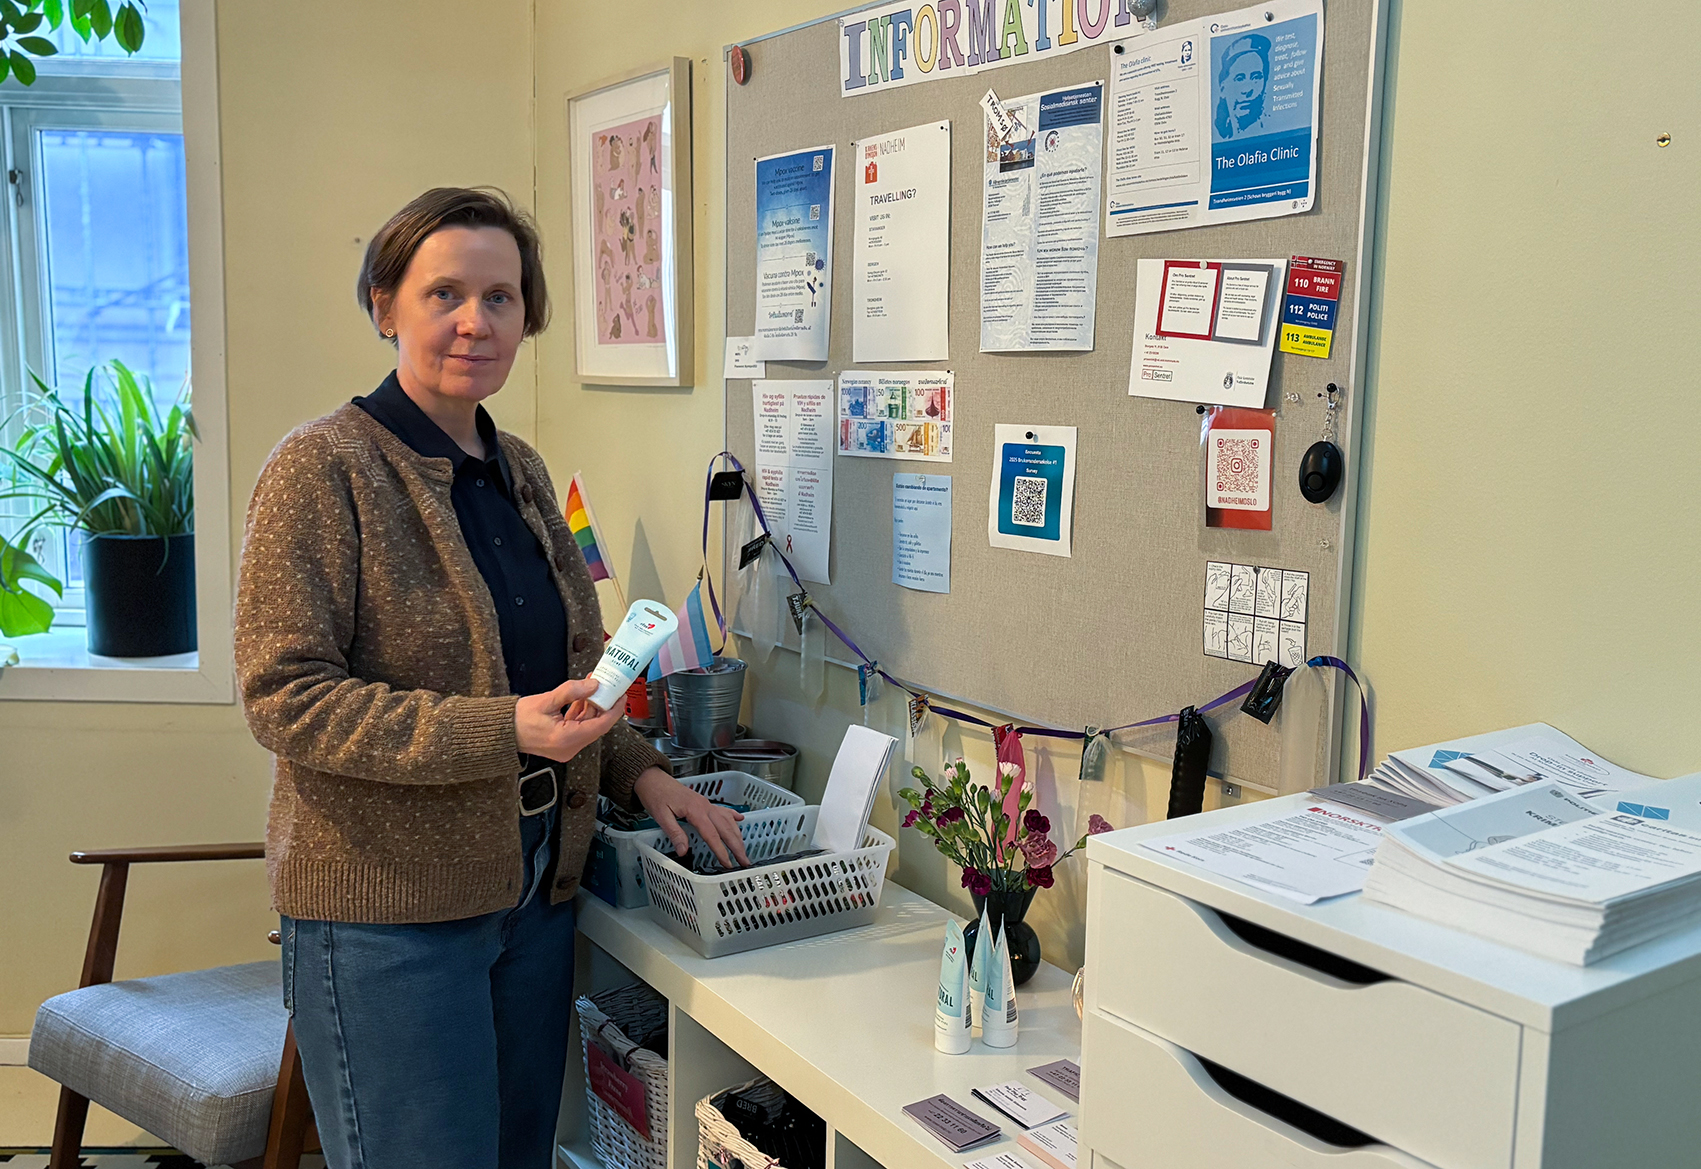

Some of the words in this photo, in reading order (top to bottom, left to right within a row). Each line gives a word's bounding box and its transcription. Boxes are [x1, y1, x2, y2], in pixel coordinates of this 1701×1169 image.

[842, 0, 1147, 92] INFORMATIO
[1283, 61, 1293, 69] and
[1294, 60, 1305, 68] give
[1273, 72, 1290, 81] advice
[1290, 69, 1305, 77] about
[1273, 82, 1294, 91] Sexually
[1273, 90, 1304, 102] Transmitted
[1272, 101, 1298, 112] Infections
[879, 137, 906, 156] NADHEIM
[1216, 157, 1235, 170] The
[1237, 150, 1267, 166] Olafia
[1270, 145, 1299, 161] Clinic
[870, 188, 917, 206] TRAVELLING?
[791, 269, 804, 278] Mpox
[1294, 278, 1309, 289] 110
[1313, 276, 1335, 285] BRANN
[1316, 285, 1329, 293] FIRE
[1289, 304, 1304, 315] 112
[1309, 303, 1329, 312] POLITI
[1307, 312, 1328, 321] POLICE
[1286, 332, 1300, 343] 113
[1143, 370, 1152, 378] Pro
[1154, 371, 1171, 380] Sentret
[841, 388, 851, 396] 1000
[914, 388, 925, 397] 100
[857, 422, 867, 430] 200
[895, 423, 906, 432] 500
[1217, 496, 1257, 506] @NADHEIMOSLO
[605, 645, 640, 671] NATURAL
[1317, 809, 1382, 832] NORSKTR
[736, 1099, 758, 1114] BRED
